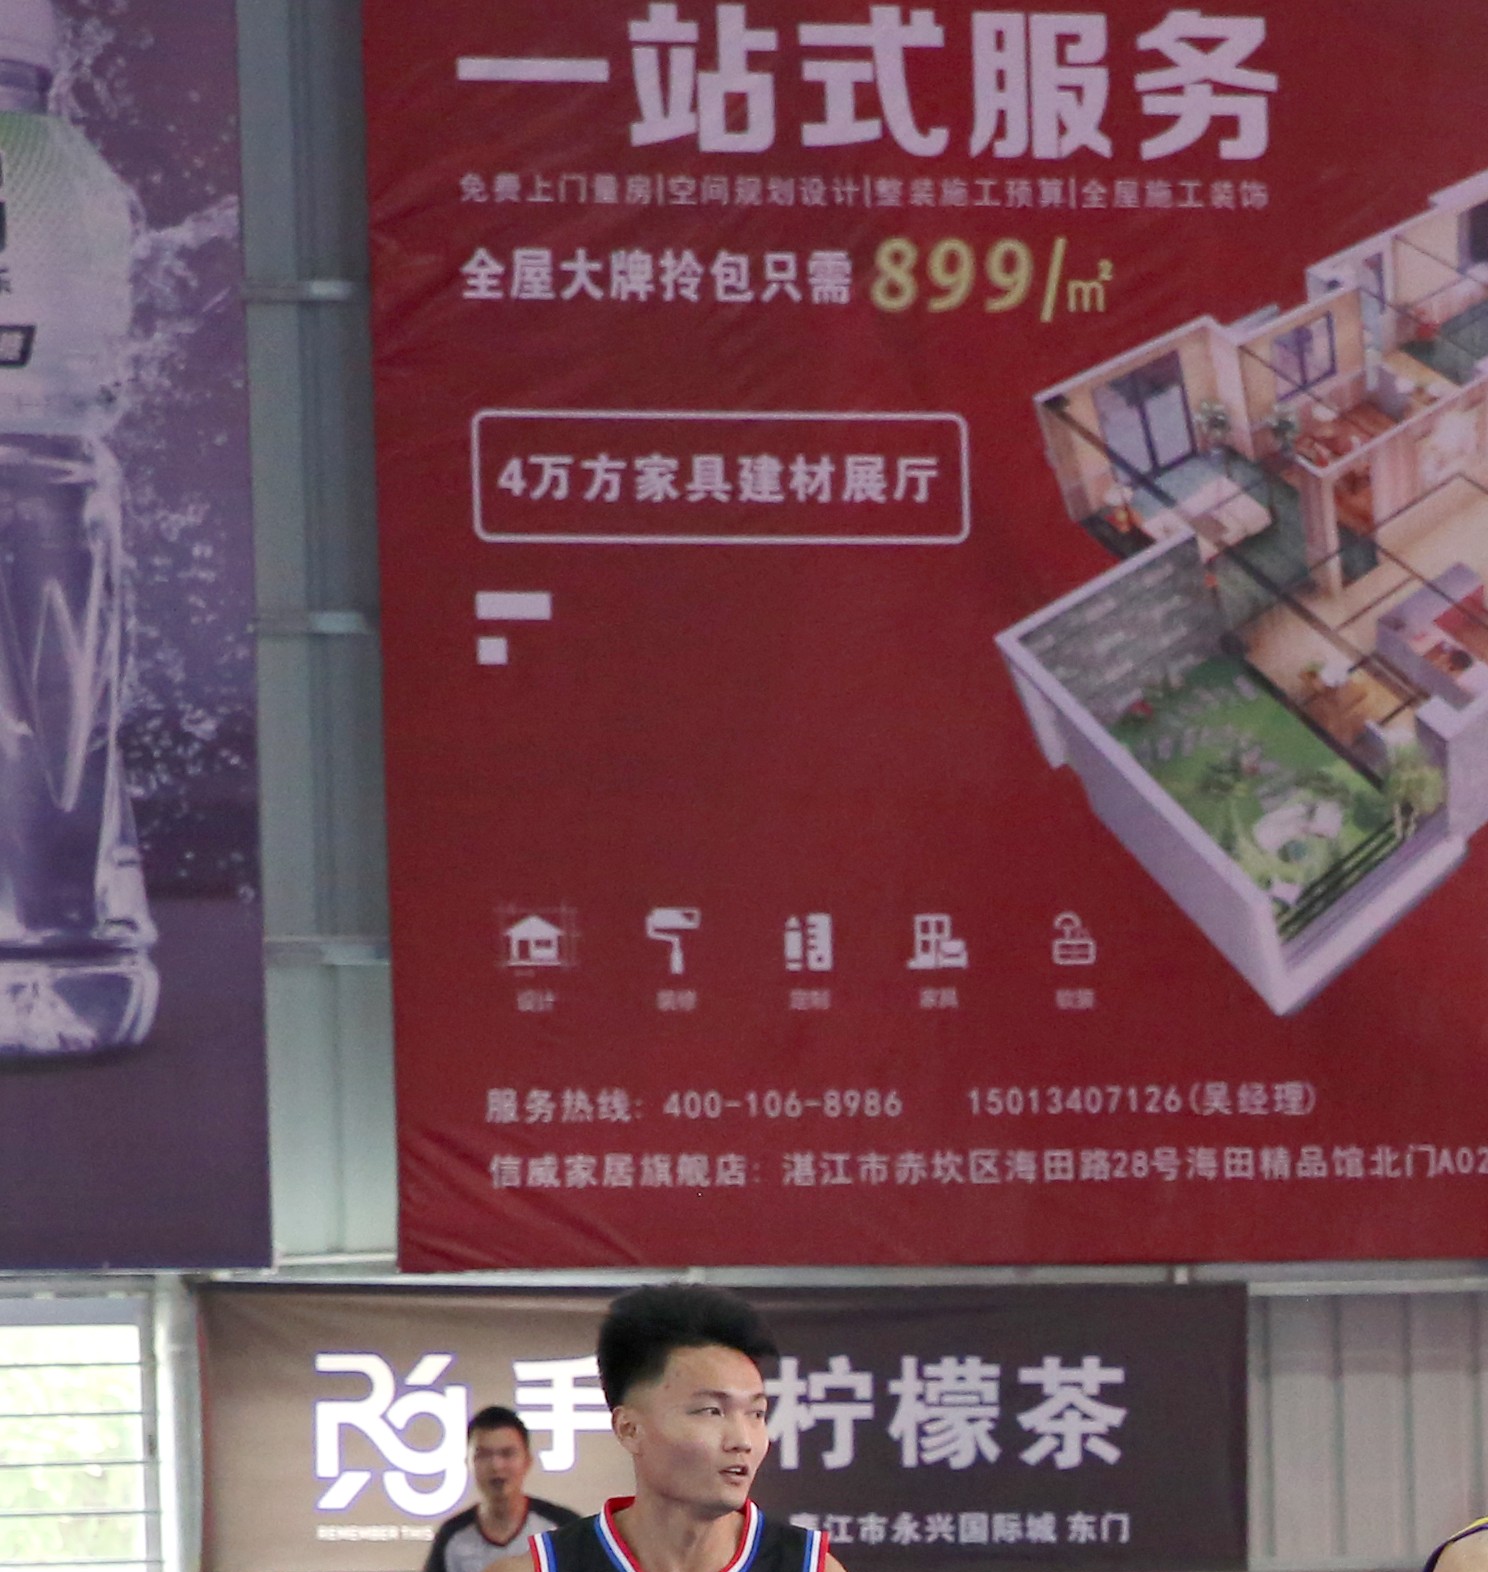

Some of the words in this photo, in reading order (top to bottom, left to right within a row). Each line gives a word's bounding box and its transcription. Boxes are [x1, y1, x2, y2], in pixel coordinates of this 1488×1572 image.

[456, 3, 1279, 161] 一站式服务
[461, 247, 853, 304] 全屋大牌拎包只需
[497, 453, 939, 505] 4万方家具建材展厅
[663, 1090, 902, 1119] 400-106-8986
[1067, 1511, 1131, 1544] 东门
